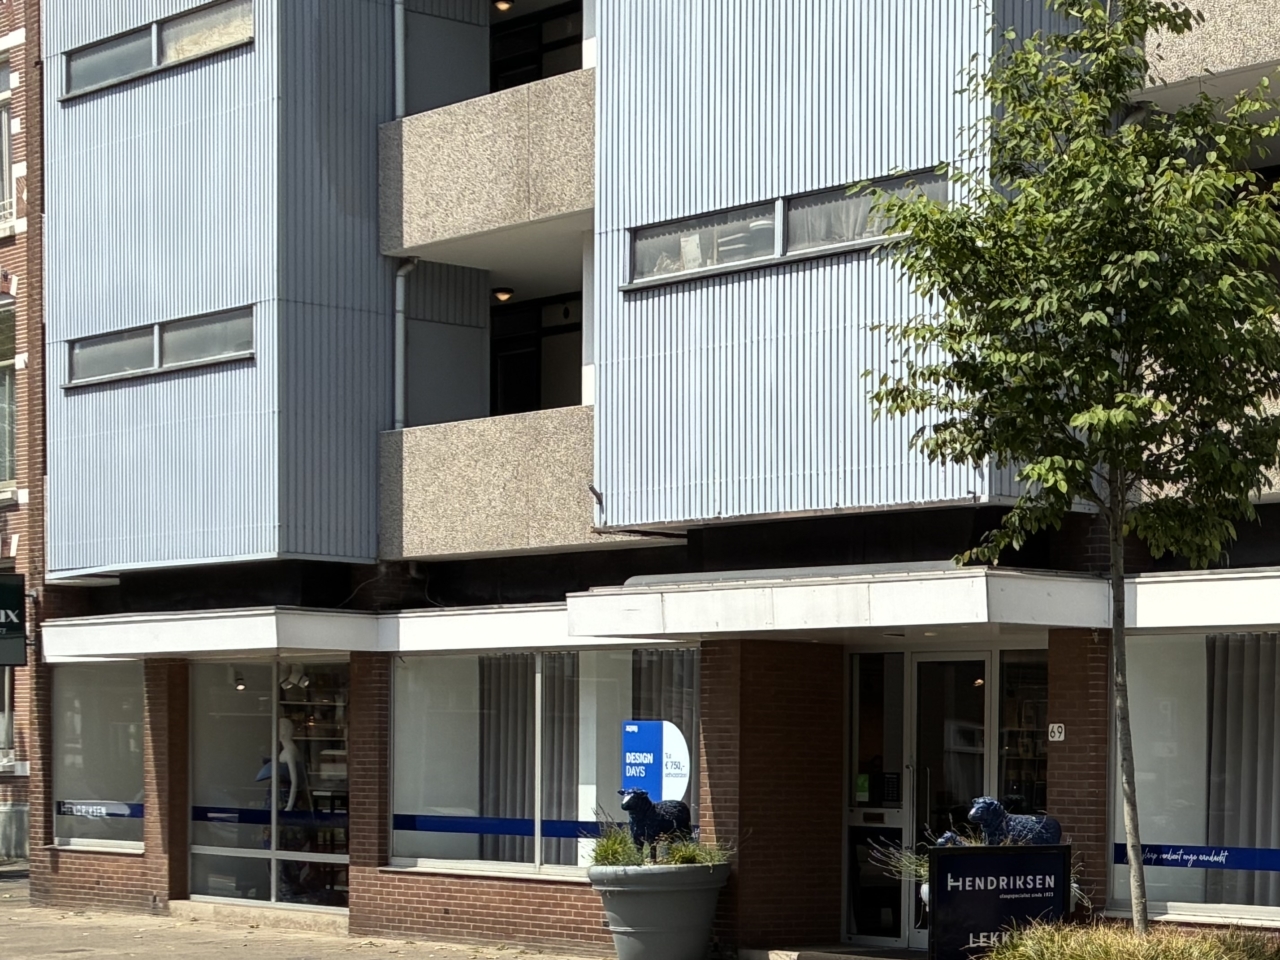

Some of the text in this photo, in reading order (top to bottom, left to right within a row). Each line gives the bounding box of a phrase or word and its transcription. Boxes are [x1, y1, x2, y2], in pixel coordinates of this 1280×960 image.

[1050, 725, 1063, 739] 69
[625, 752, 654, 764] DESIGN
[625, 765, 646, 777] DAYS
[947, 873, 1055, 891] HENDRIKSEN
